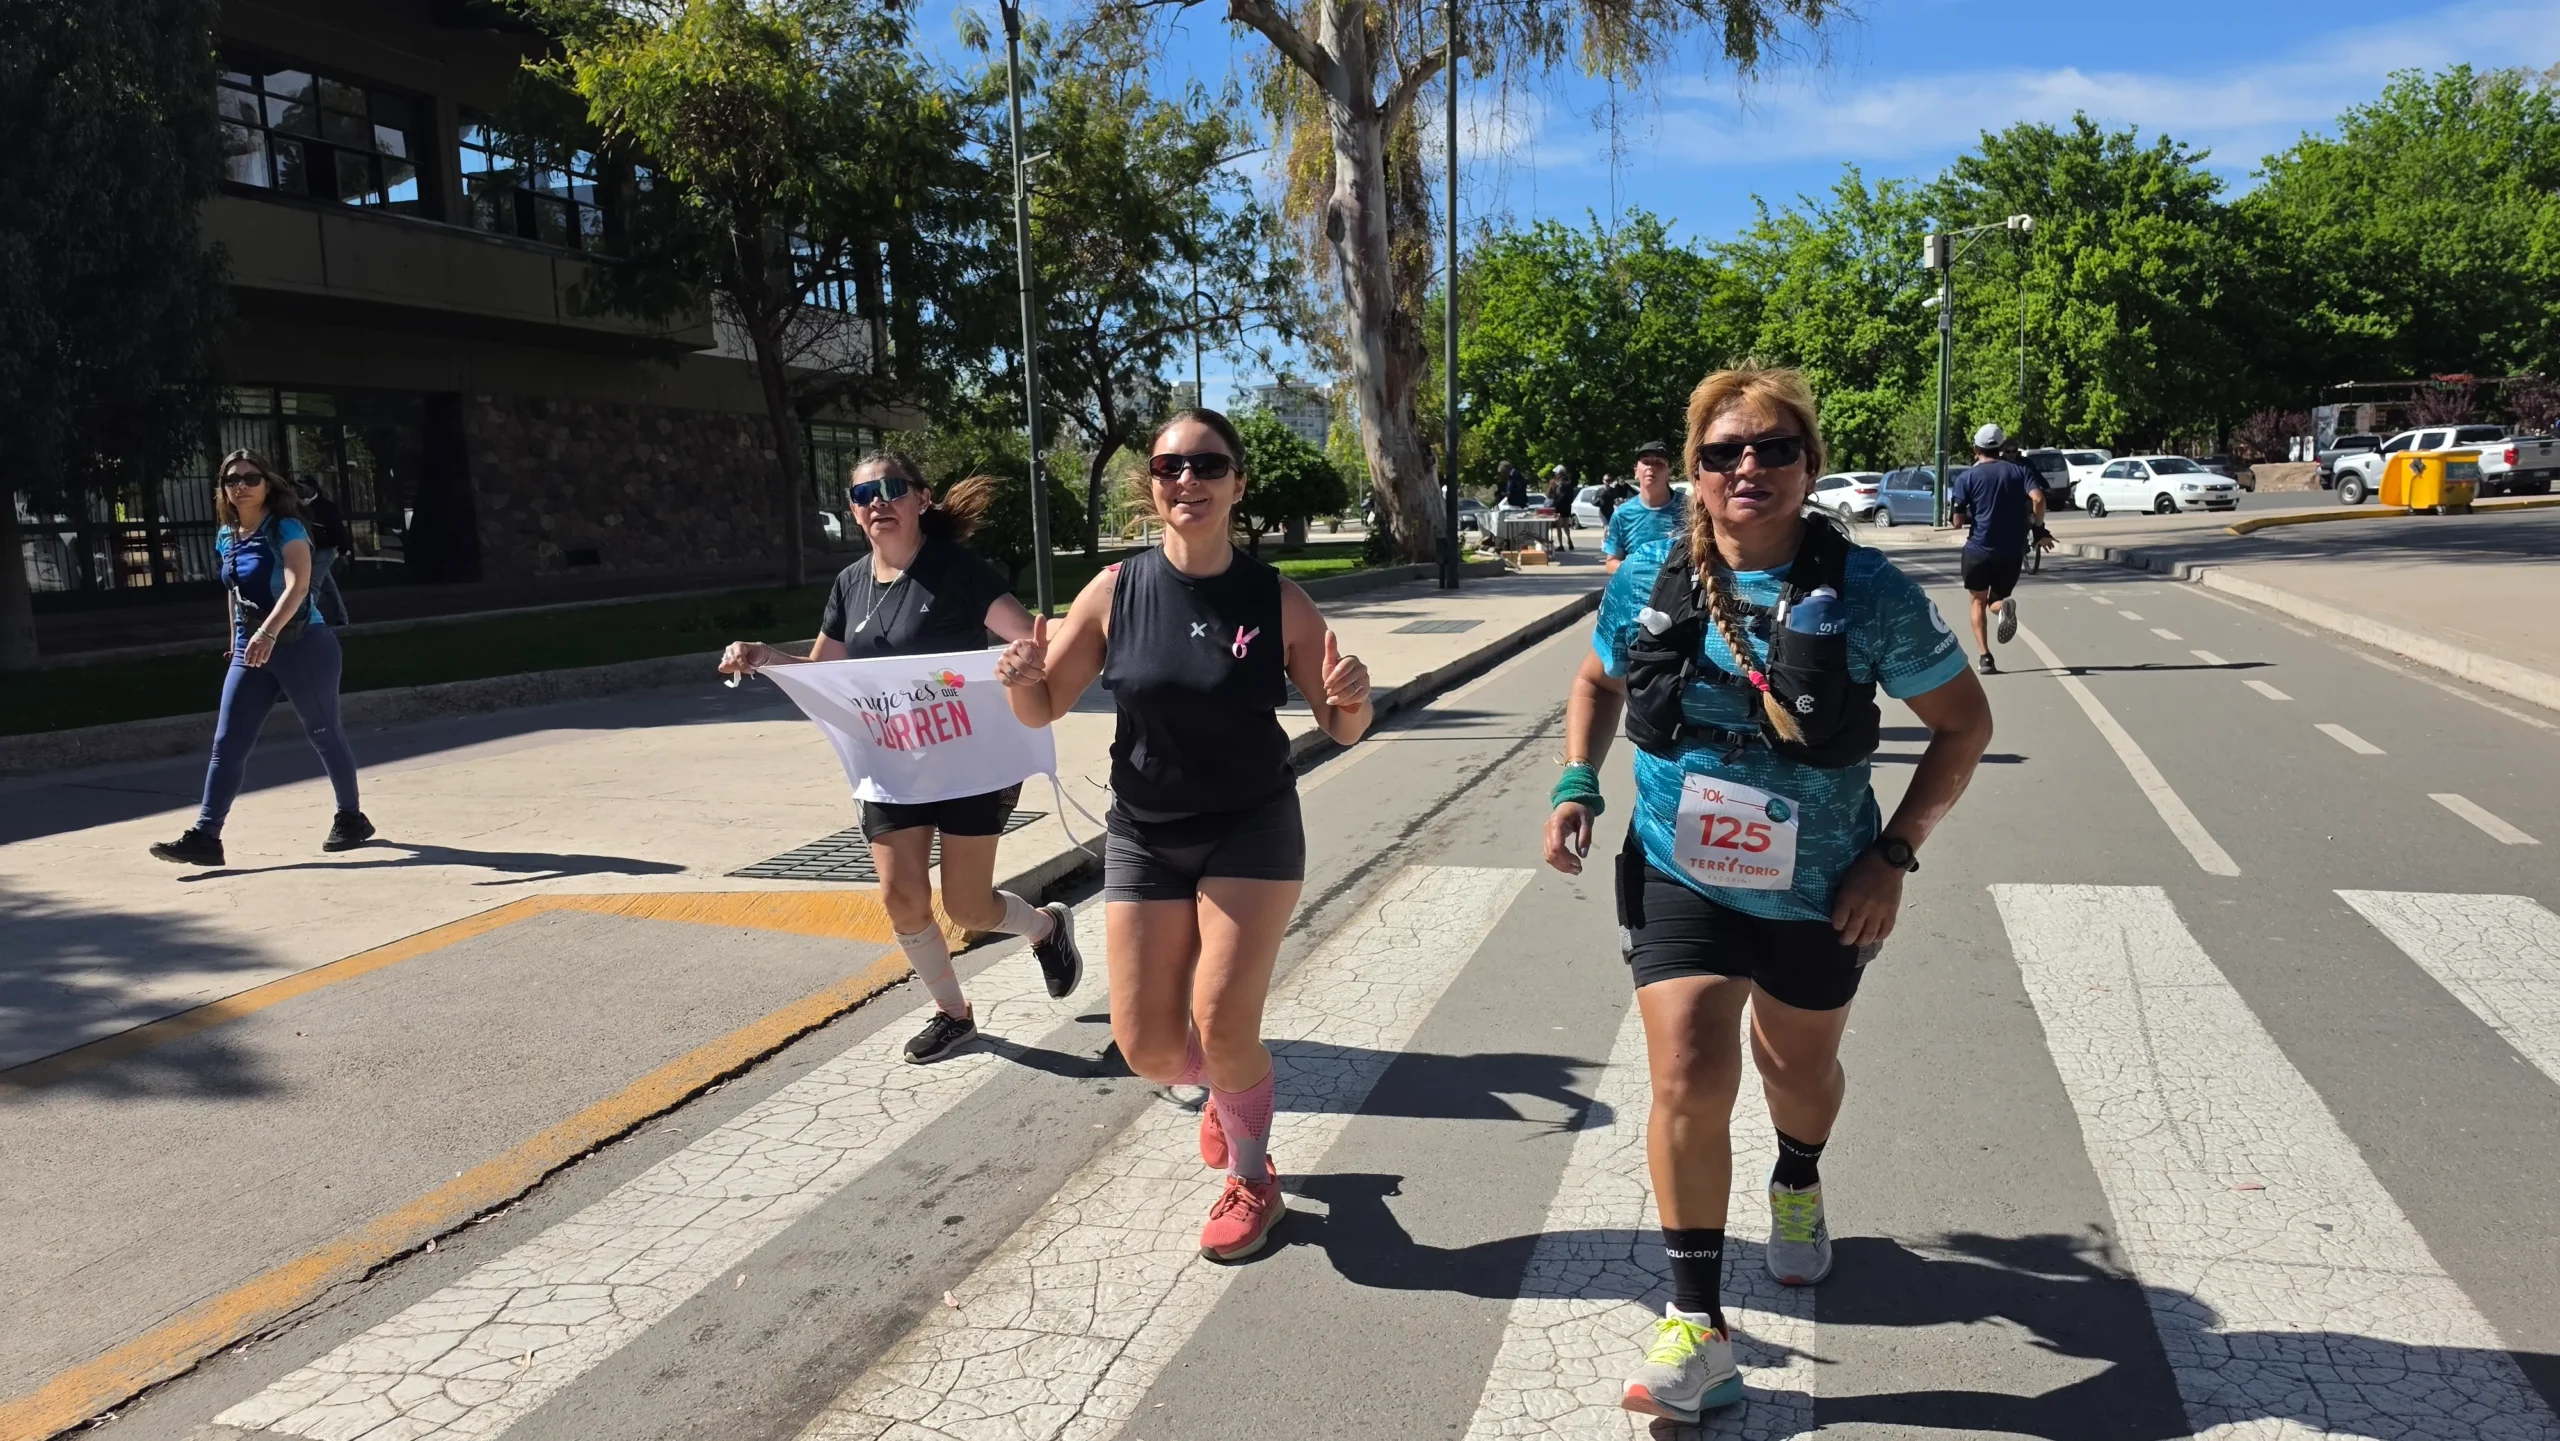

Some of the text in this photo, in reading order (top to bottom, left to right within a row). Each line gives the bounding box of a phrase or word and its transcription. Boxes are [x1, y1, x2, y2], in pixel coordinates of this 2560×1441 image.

[941, 688, 959, 698] QUE
[1702, 787, 1725, 805] 10k
[1699, 813, 1772, 853] 125
